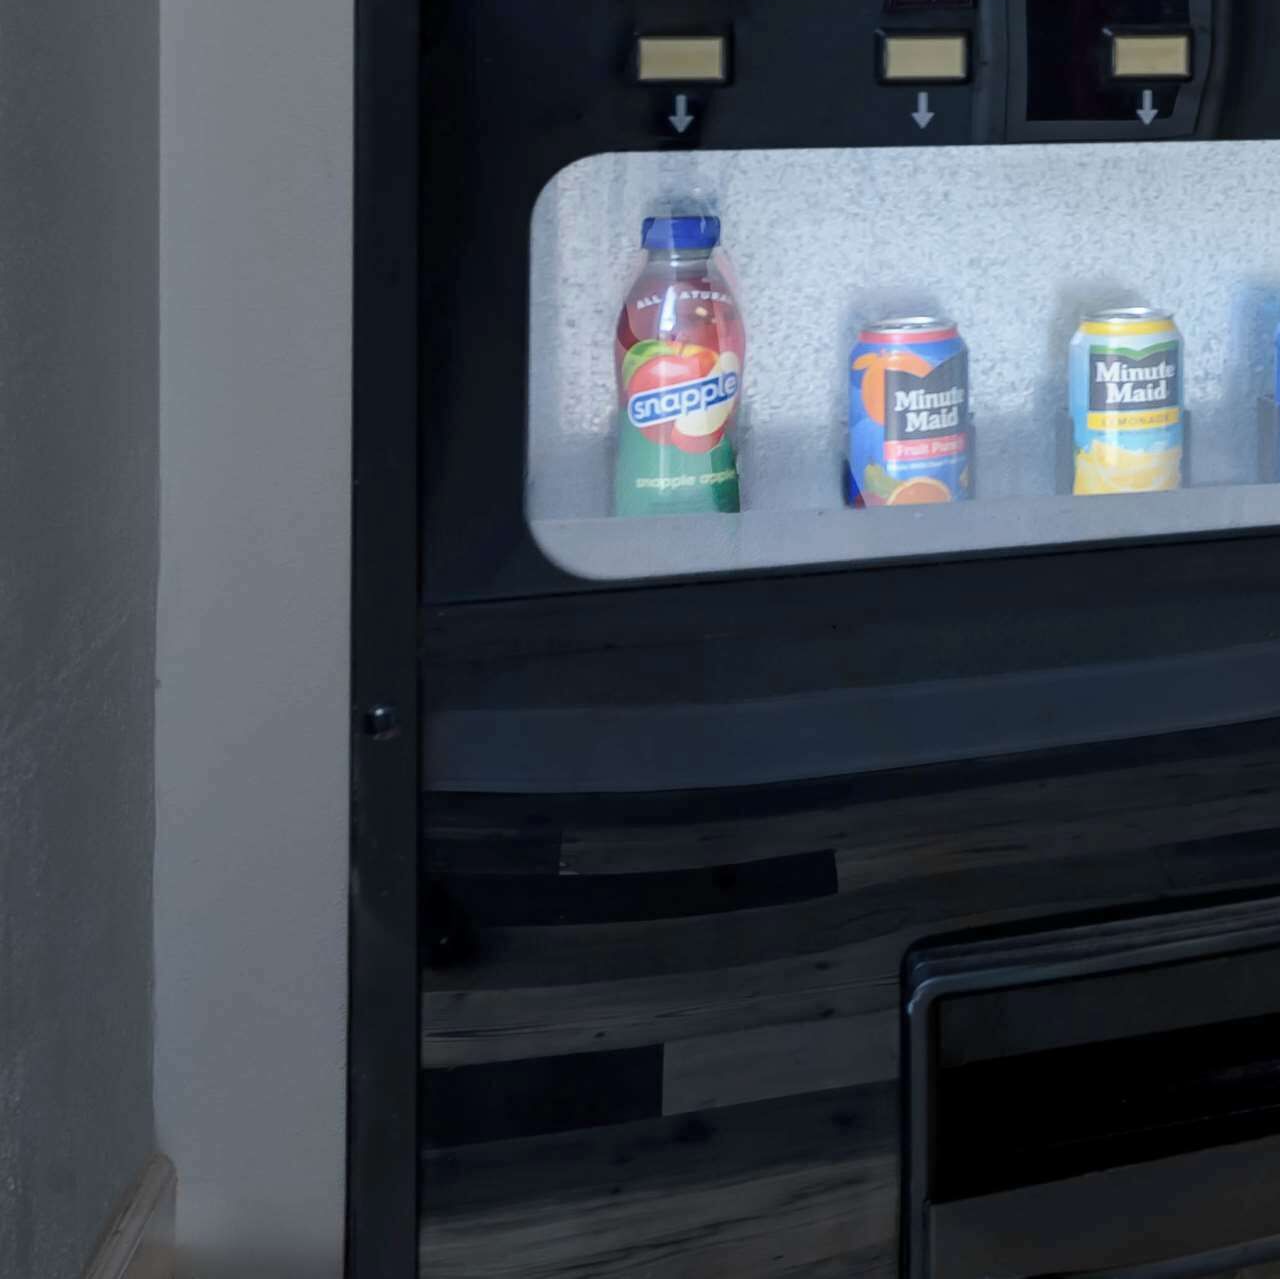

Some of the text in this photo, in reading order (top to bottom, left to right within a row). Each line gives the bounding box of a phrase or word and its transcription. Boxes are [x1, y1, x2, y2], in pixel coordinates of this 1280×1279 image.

[637, 290, 733, 309] ALL ATURA
[1095, 360, 1176, 382] Minute
[633, 373, 737, 420] snapple
[1106, 380, 1168, 403] Maid
[905, 407, 959, 432] Maid
